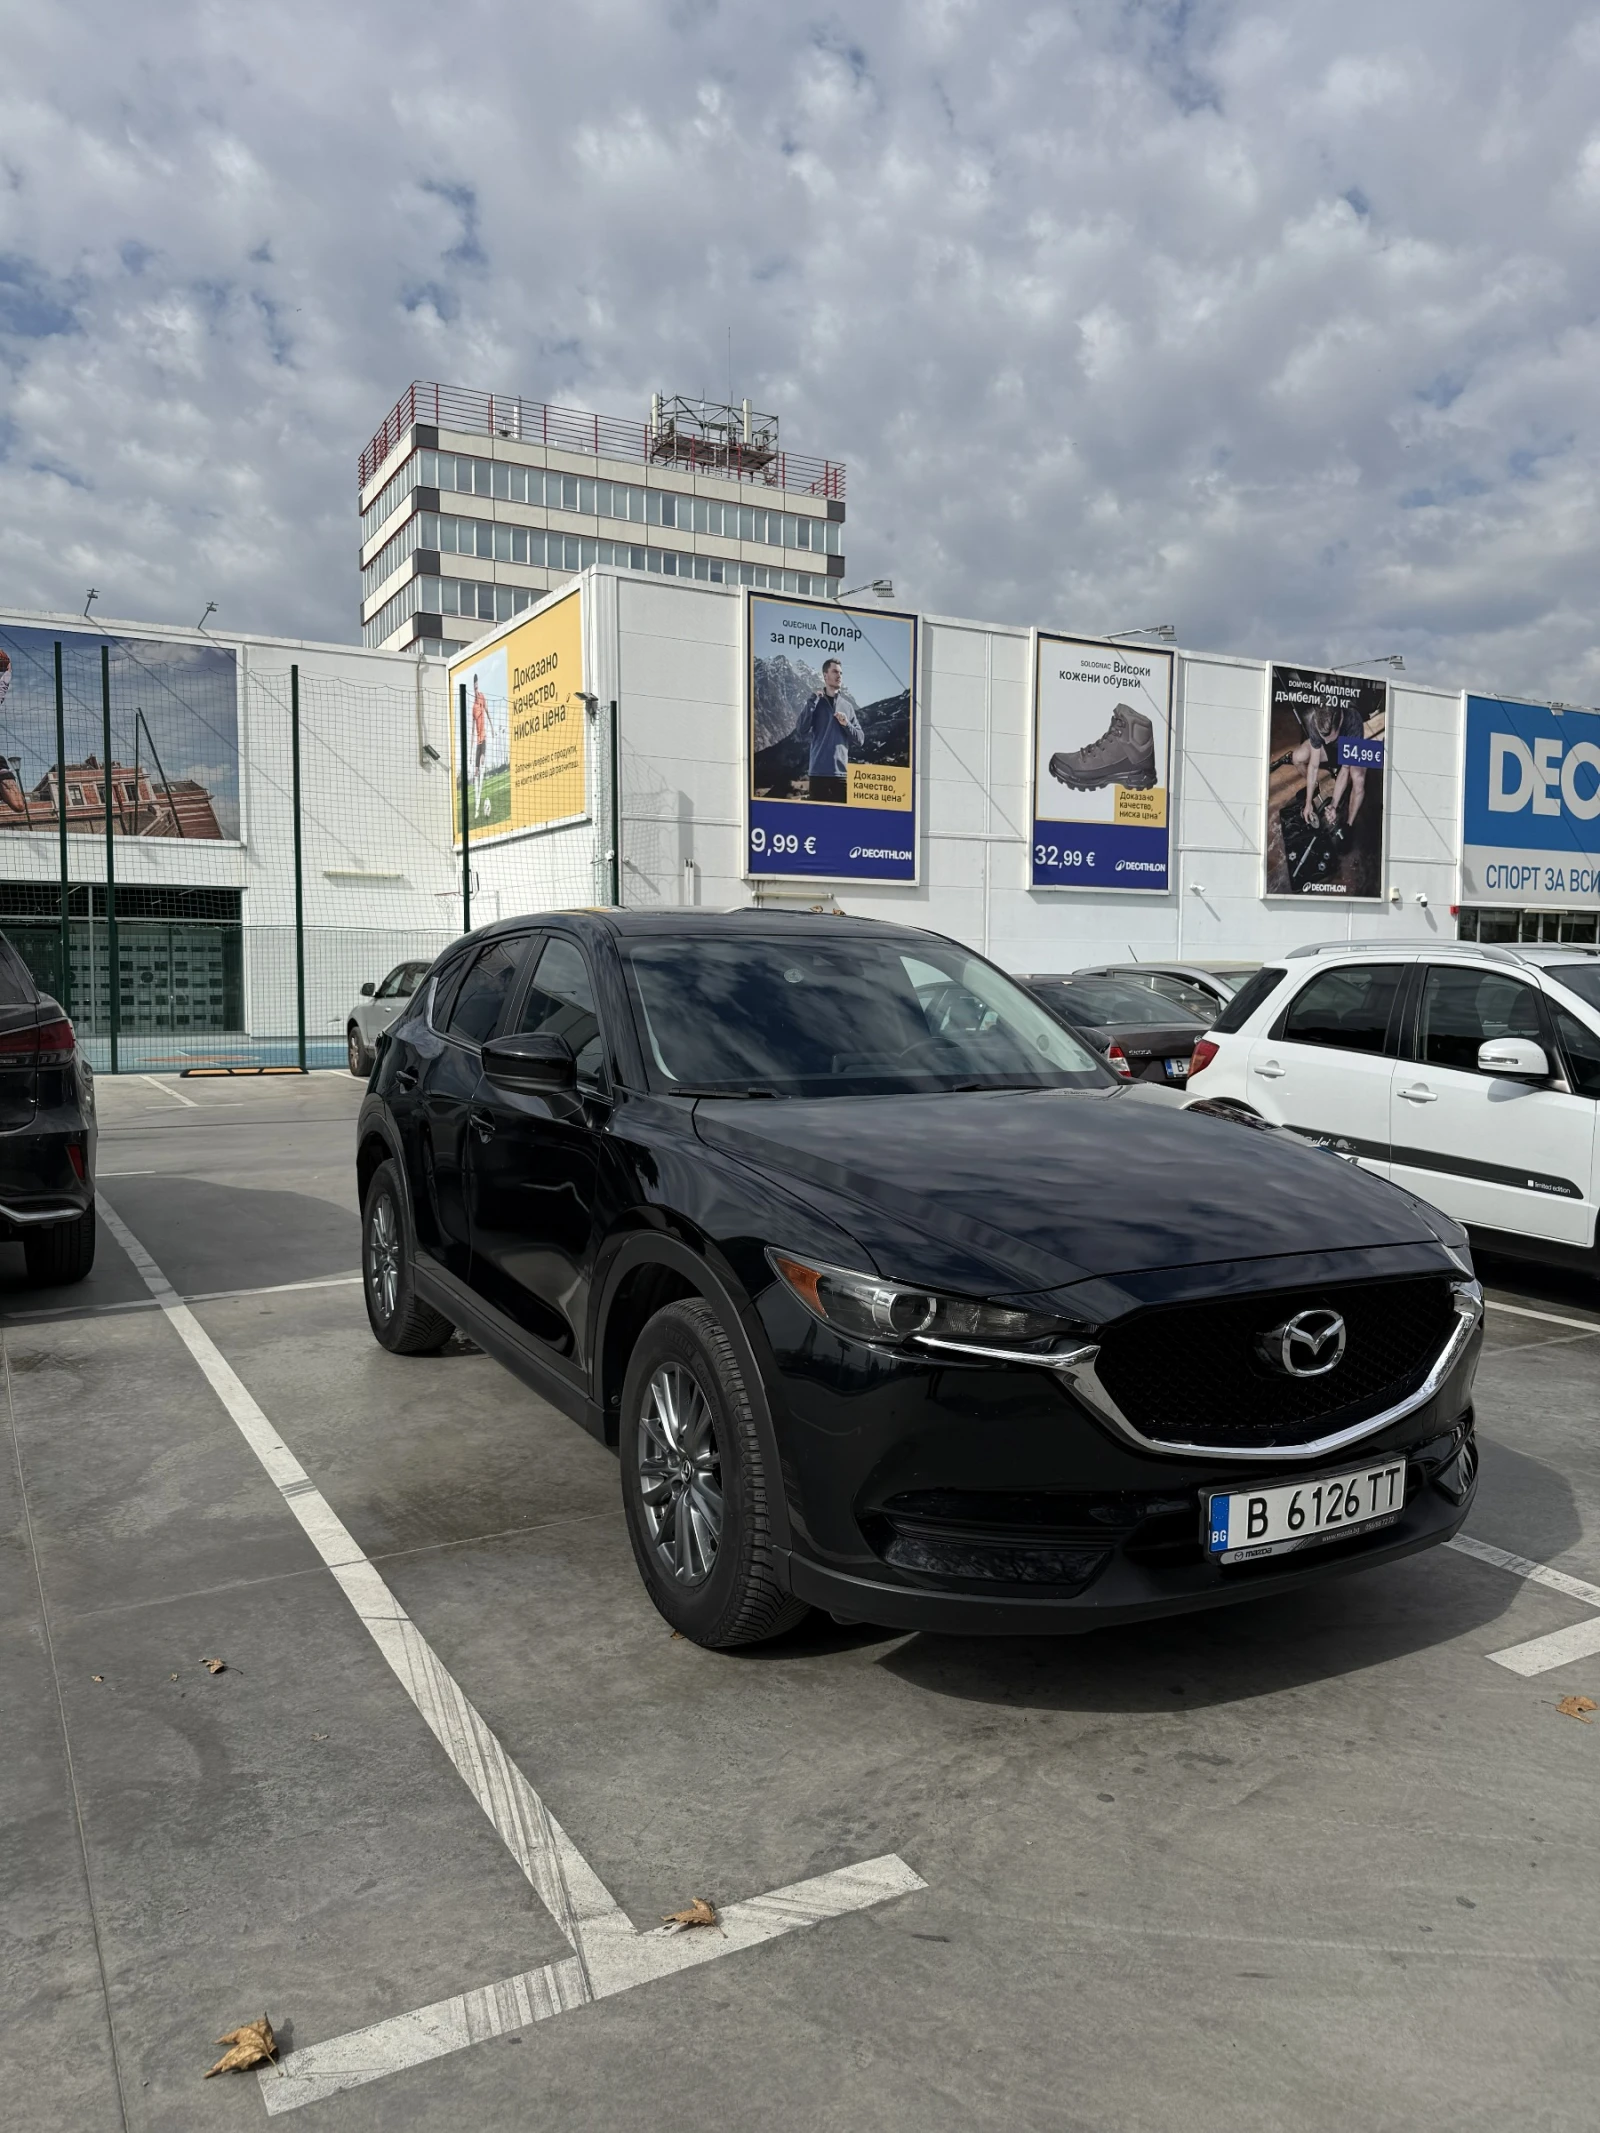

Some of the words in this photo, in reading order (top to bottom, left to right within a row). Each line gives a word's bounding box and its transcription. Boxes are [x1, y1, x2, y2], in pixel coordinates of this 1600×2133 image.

[782, 620, 818, 632] QUECHUA
[821, 621, 863, 641] Полар
[770, 631, 785, 644] за
[788, 635, 846, 652] преходи
[513, 652, 559, 694] Доказано
[1080, 660, 1111, 670] SOLOGNAC
[1113, 661, 1151, 678] Високи
[1059, 670, 1100, 683] кожени
[1103, 674, 1141, 688] обувки
[1288, 680, 1312, 690] DOMYOS
[1313, 681, 1361, 698] Комплект
[513, 681, 559, 717] качество,
[1275, 691, 1323, 707] дъмбели,
[1325, 695, 1338, 707] 20
[1340, 699, 1351, 708] кг
[514, 715, 541, 742] ниска
[542, 703, 567, 731] цена
[1343, 744, 1374, 761] 54,99
[1374, 751, 1381, 762] €
[854, 770, 897, 782] Доказано
[1488, 732, 1600, 820] DEC
[854, 781, 896, 793] качество,
[854, 792, 879, 801] ниска
[882, 794, 902, 803] цена
[1120, 792, 1154, 802] Доказано
[1120, 802, 1153, 812] качество,
[1120, 811, 1141, 819] ниска
[750, 827, 799, 857] 9,99
[804, 836, 817, 855] €
[862, 848, 912, 861] DECATHLON
[1035, 845, 1082, 869] 32,99
[1086, 852, 1096, 866] €
[1126, 861, 1166, 872] DECATHLON
[1486, 864, 1541, 890] СПОРТ
[1544, 868, 1565, 891] ЗА
[1311, 883, 1347, 893] DECATHLON
[1535, 1182, 1552, 1190] limited
[1552, 1186, 1571, 1194] edition
[1247, 1497, 1268, 1540] B
[1287, 1478, 1360, 1530] 6126
[1367, 1467, 1401, 1512] TT
[1212, 1530, 1226, 1544] BG
[1322, 1527, 1360, 1542] www.mazda.bg
